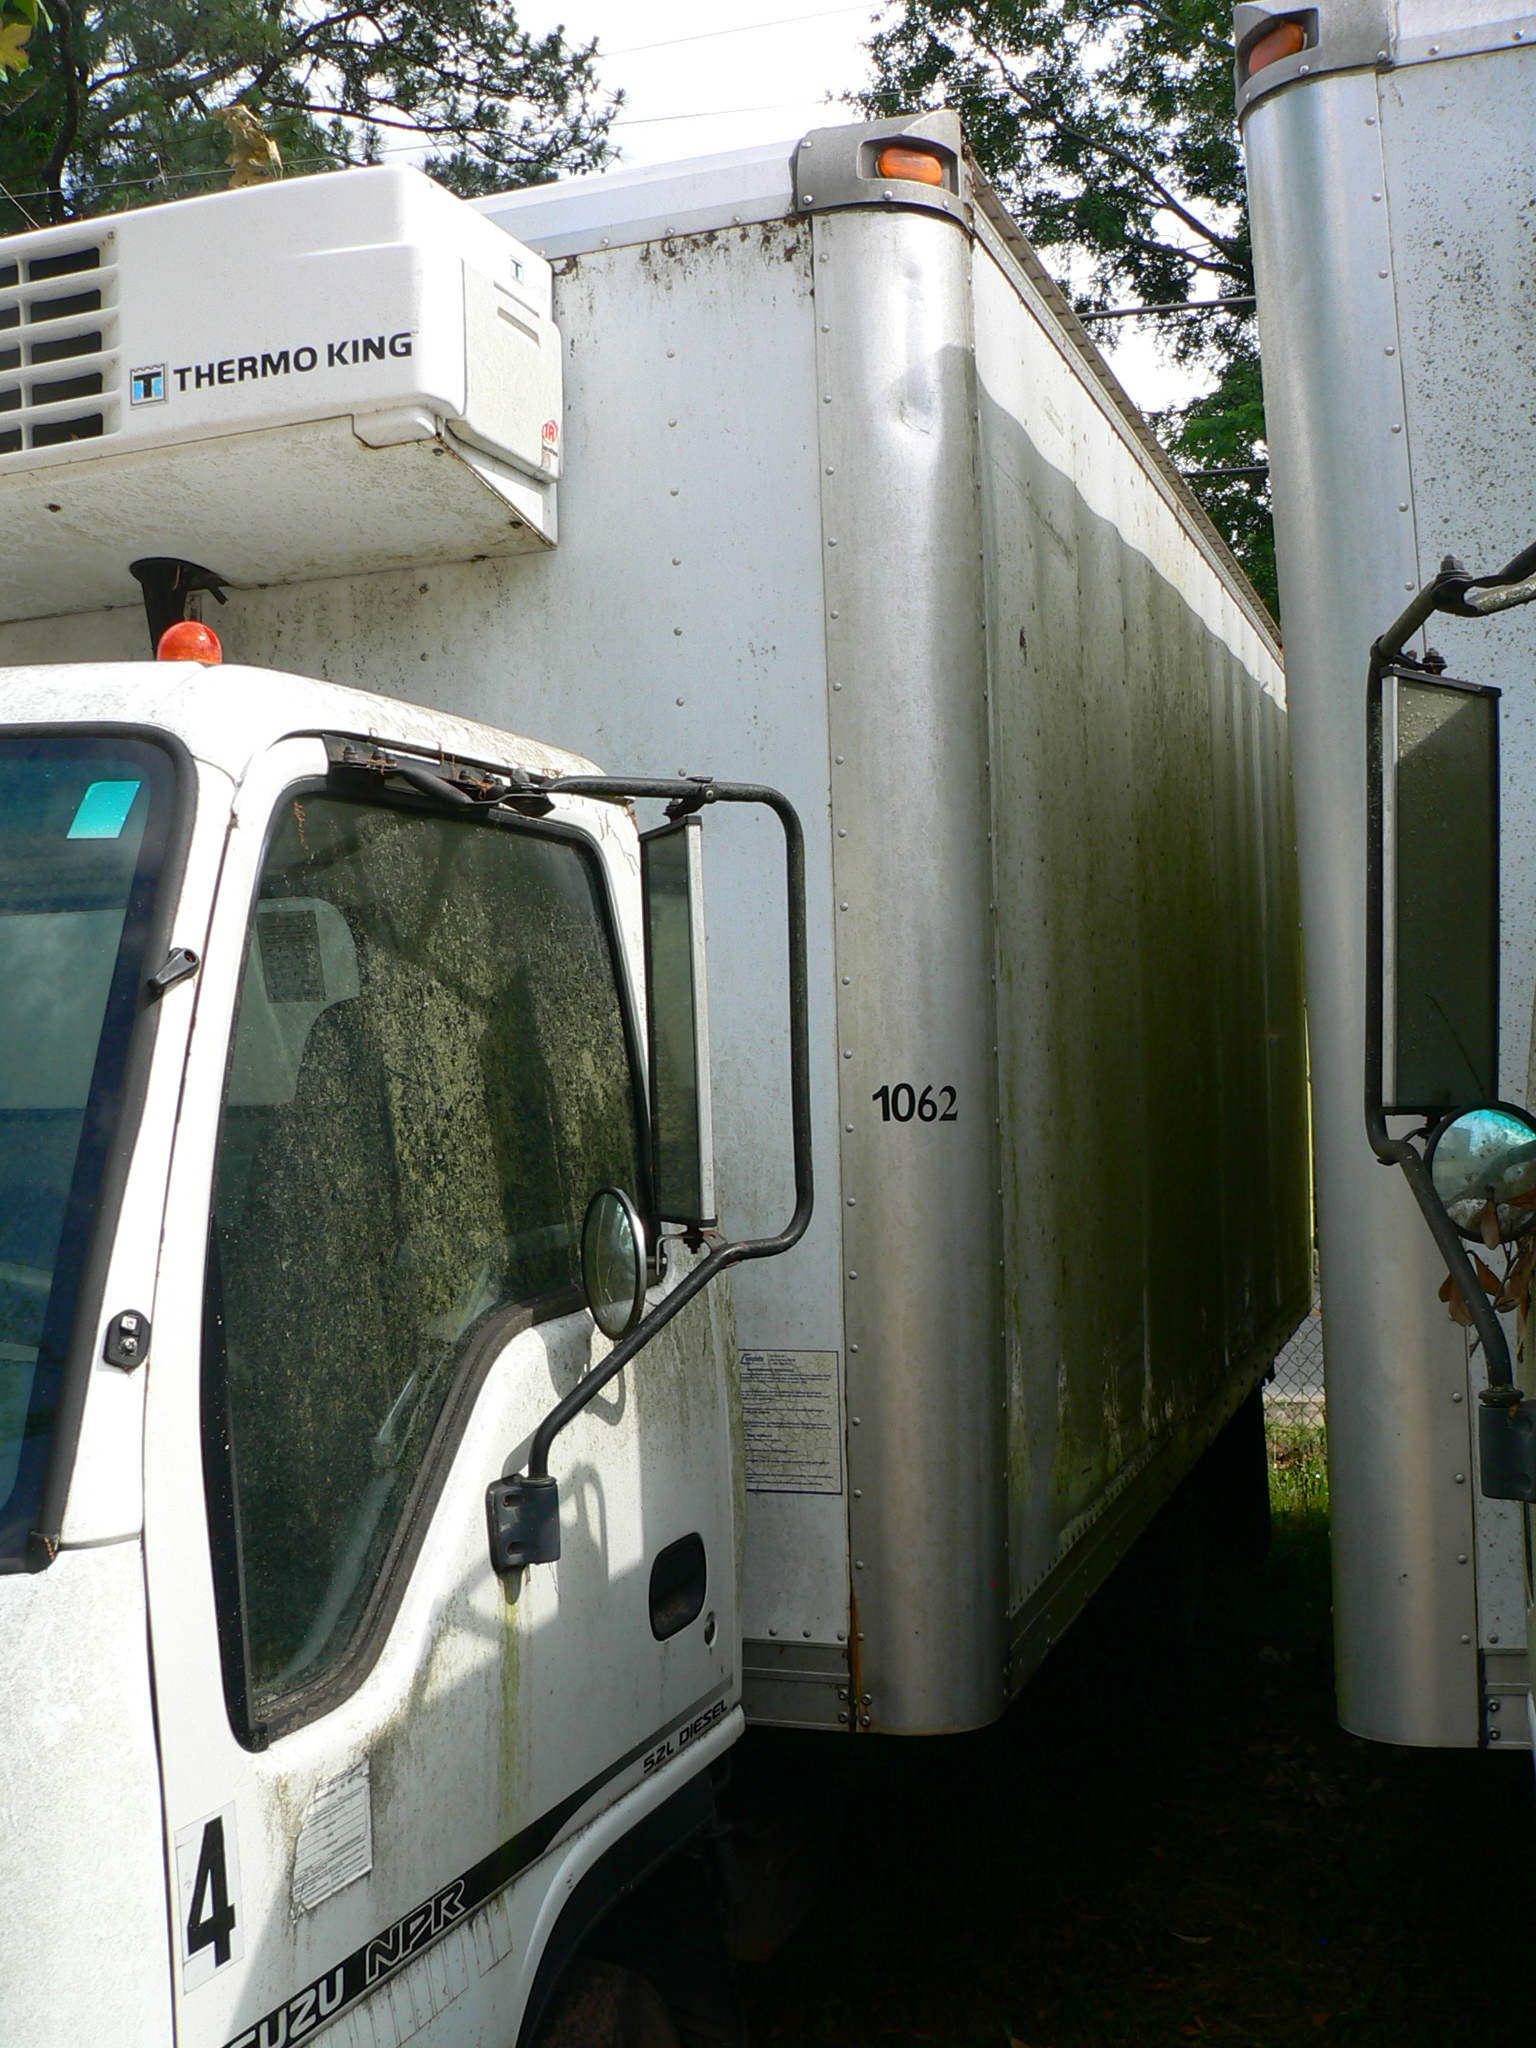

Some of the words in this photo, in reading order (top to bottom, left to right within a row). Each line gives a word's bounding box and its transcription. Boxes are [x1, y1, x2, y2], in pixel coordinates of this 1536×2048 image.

[173, 346, 318, 392] THERMO
[327, 332, 412, 367] KING
[872, 1083, 958, 1122] 1062
[679, 1699, 727, 1746] DIESEL
[187, 1815, 236, 1968] 4
[366, 1879, 466, 1985] NPR
